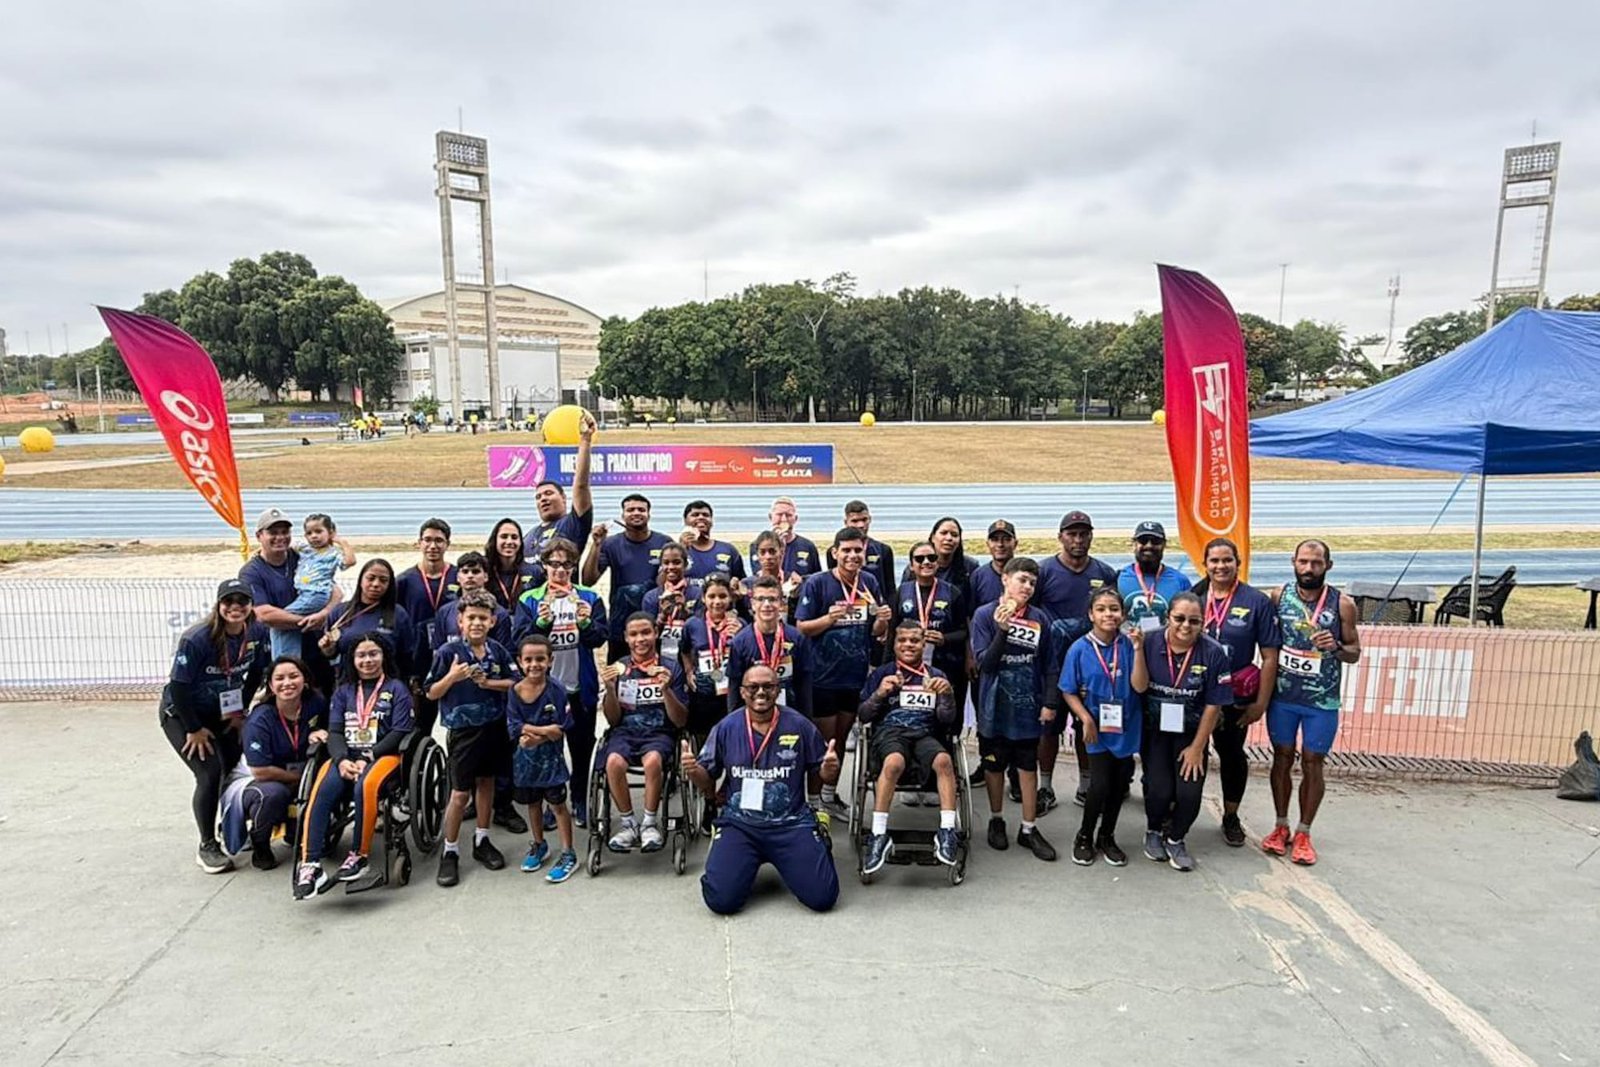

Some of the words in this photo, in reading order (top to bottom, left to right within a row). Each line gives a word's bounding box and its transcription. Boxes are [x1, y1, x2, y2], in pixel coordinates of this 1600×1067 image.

[780, 469, 813, 477] CAIXA
[551, 632, 576, 645] 210
[1008, 625, 1036, 643] 222
[1284, 655, 1312, 671] 156
[906, 693, 931, 706] 241
